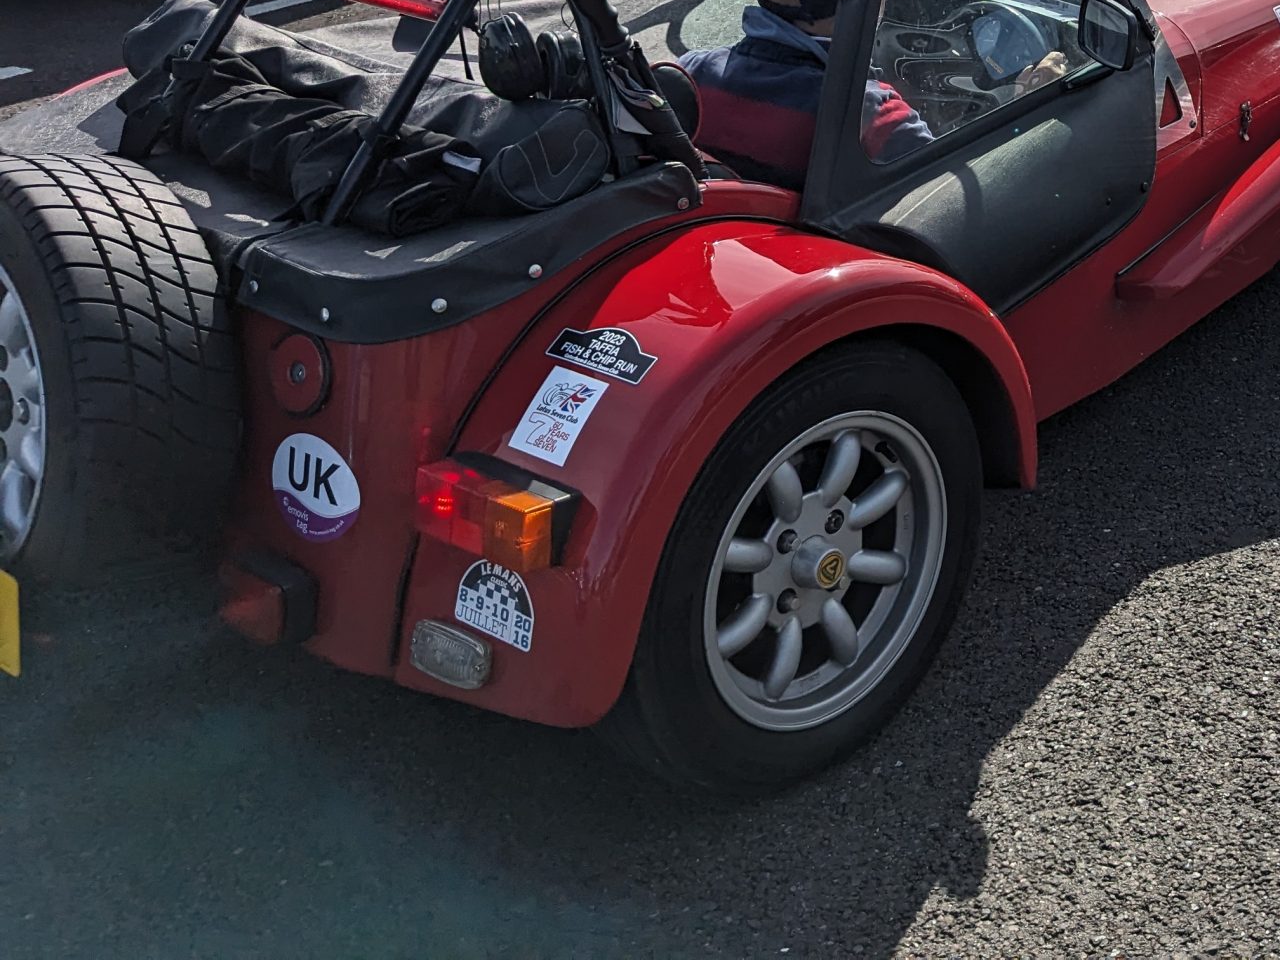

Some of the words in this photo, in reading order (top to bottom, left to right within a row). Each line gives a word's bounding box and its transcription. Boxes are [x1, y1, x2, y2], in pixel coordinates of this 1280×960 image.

[598, 330, 627, 346] 2023
[560, 341, 585, 356] FISH
[582, 348, 593, 359] &
[591, 351, 617, 366] CHIP
[614, 359, 639, 374] RUN
[588, 339, 622, 357] TAFFIA
[536, 403, 552, 414] Lotus
[550, 409, 567, 420] Seven
[566, 414, 579, 424] Club
[550, 428, 570, 441] YEARS
[534, 438, 557, 453] SEVEN
[288, 445, 342, 507] UK
[287, 505, 309, 522] emovis
[296, 519, 308, 534] tag
[480, 562, 492, 576] LE
[492, 563, 522, 593] MANS
[490, 575, 508, 589] CLASSIC
[456, 603, 508, 638] JUILLET
[514, 613, 532, 634] 20
[513, 630, 529, 650] 16
